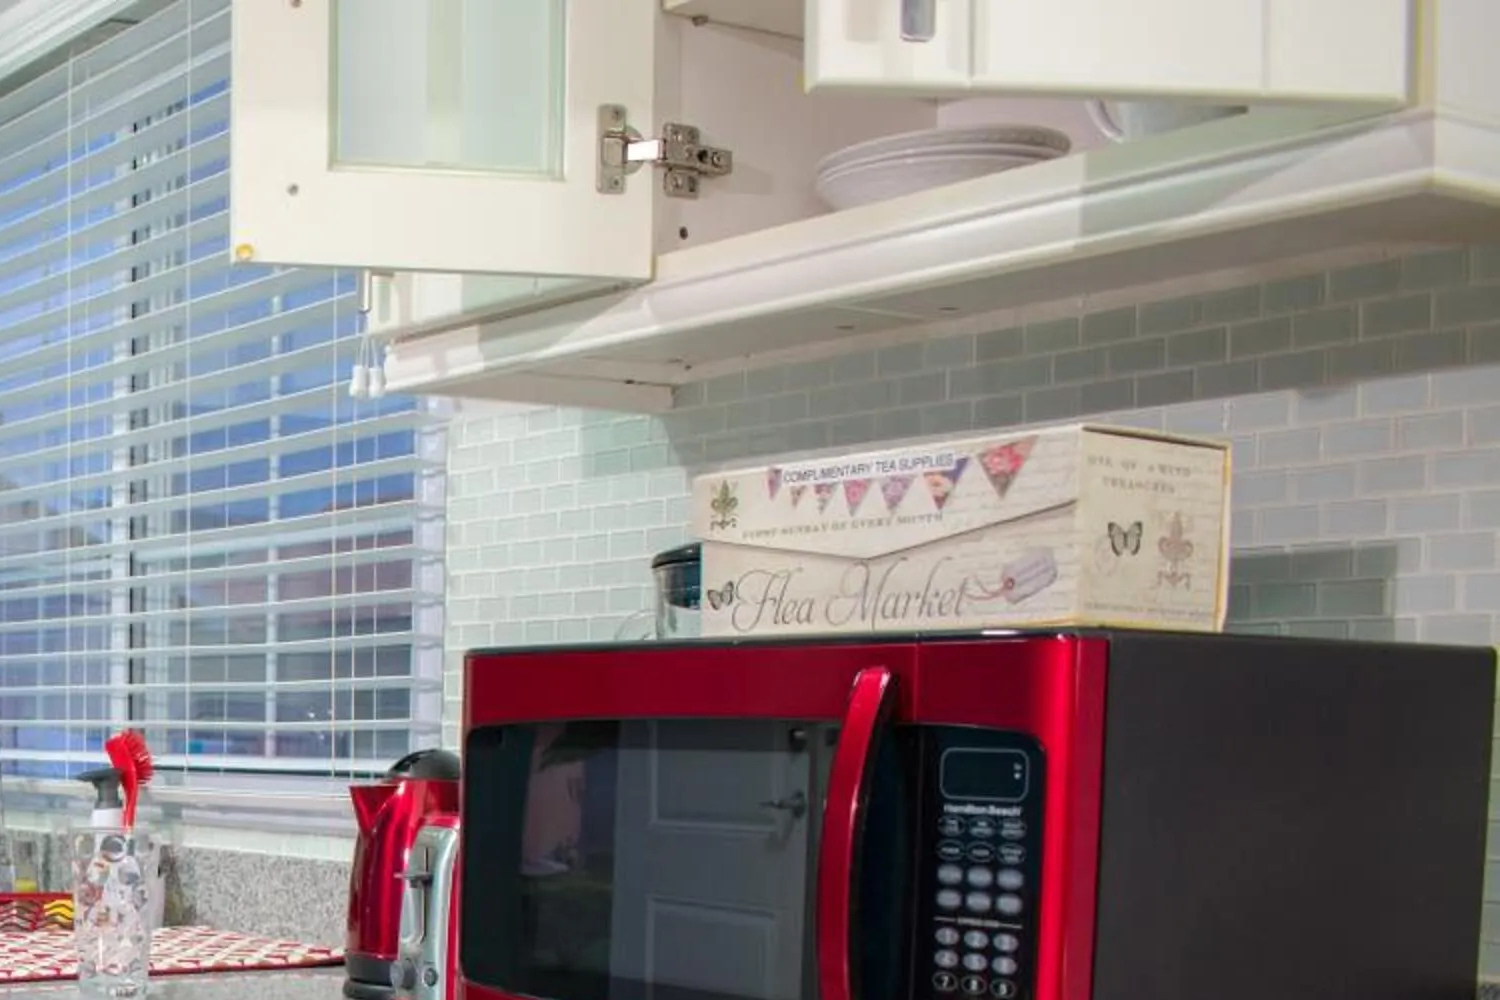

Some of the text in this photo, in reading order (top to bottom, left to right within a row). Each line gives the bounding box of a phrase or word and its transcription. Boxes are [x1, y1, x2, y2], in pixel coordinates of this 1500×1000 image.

[783, 454, 954, 483] COMPLIMENTARY TEA SUPPLIES
[731, 556, 967, 632] Flea Market
